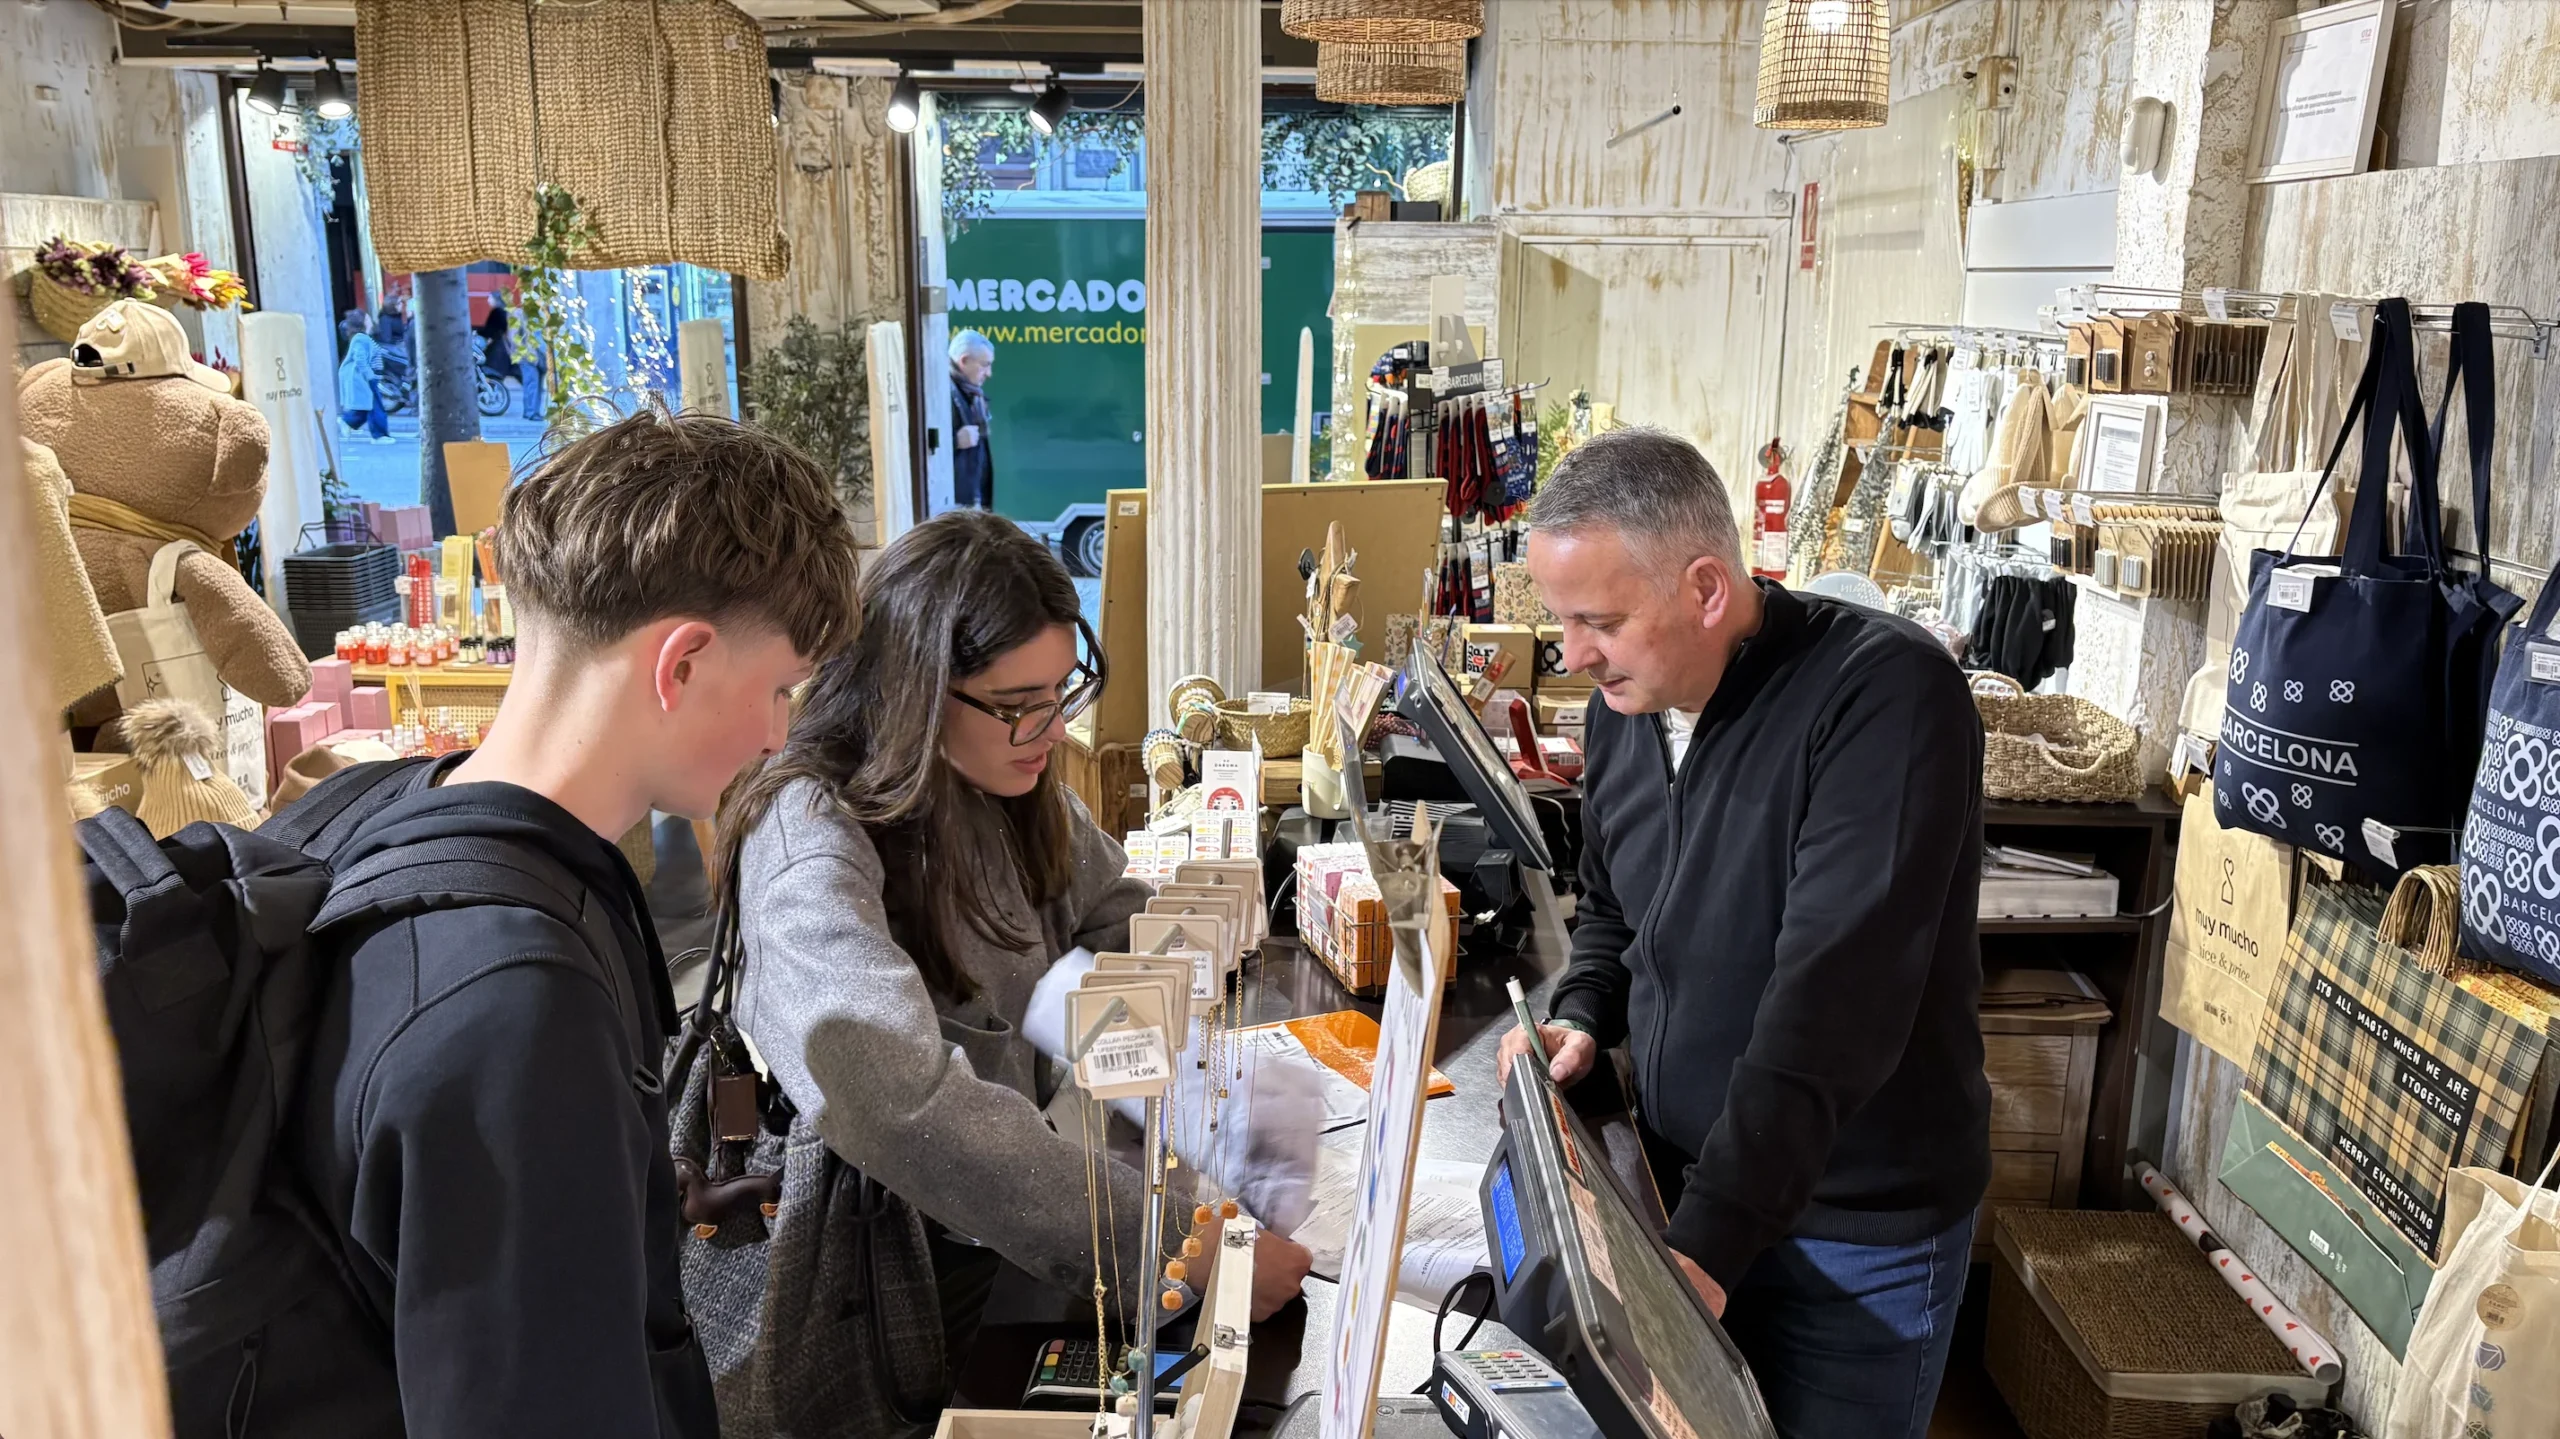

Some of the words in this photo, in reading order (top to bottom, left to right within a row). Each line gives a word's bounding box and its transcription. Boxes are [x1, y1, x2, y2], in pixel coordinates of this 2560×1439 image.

[946, 278, 1146, 313] MERCADO
[948, 321, 1146, 344] ww.mercado
[225, 705, 254, 726] mucho
[2221, 711, 2358, 777] BARCELONA
[100, 783, 131, 804] ucho
[2195, 907, 2216, 936] muy
[2219, 921, 2259, 958] mucho
[2219, 951, 2228, 970] &
[2228, 961, 2251, 983] price
[1192, 987, 1207, 996] 99€
[2336, 995, 2352, 1015] ALL
[2357, 1011, 2389, 1041] MAGIC
[2393, 1036, 2421, 1065] WHEN
[2425, 1060, 2441, 1081] WE
[2445, 1077, 2470, 1101] ARE
[1128, 1065, 1159, 1078] 14,99€
[2401, 1072, 2462, 1126] #TOGETHER
[2339, 1135, 2369, 1167] MERRY
[2372, 1166, 2433, 1230] EVERYTHING
[2366, 1186, 2385, 1209] WITH
[2387, 1207, 2402, 1225] MUY
[2404, 1224, 2428, 1251] MUCHO
